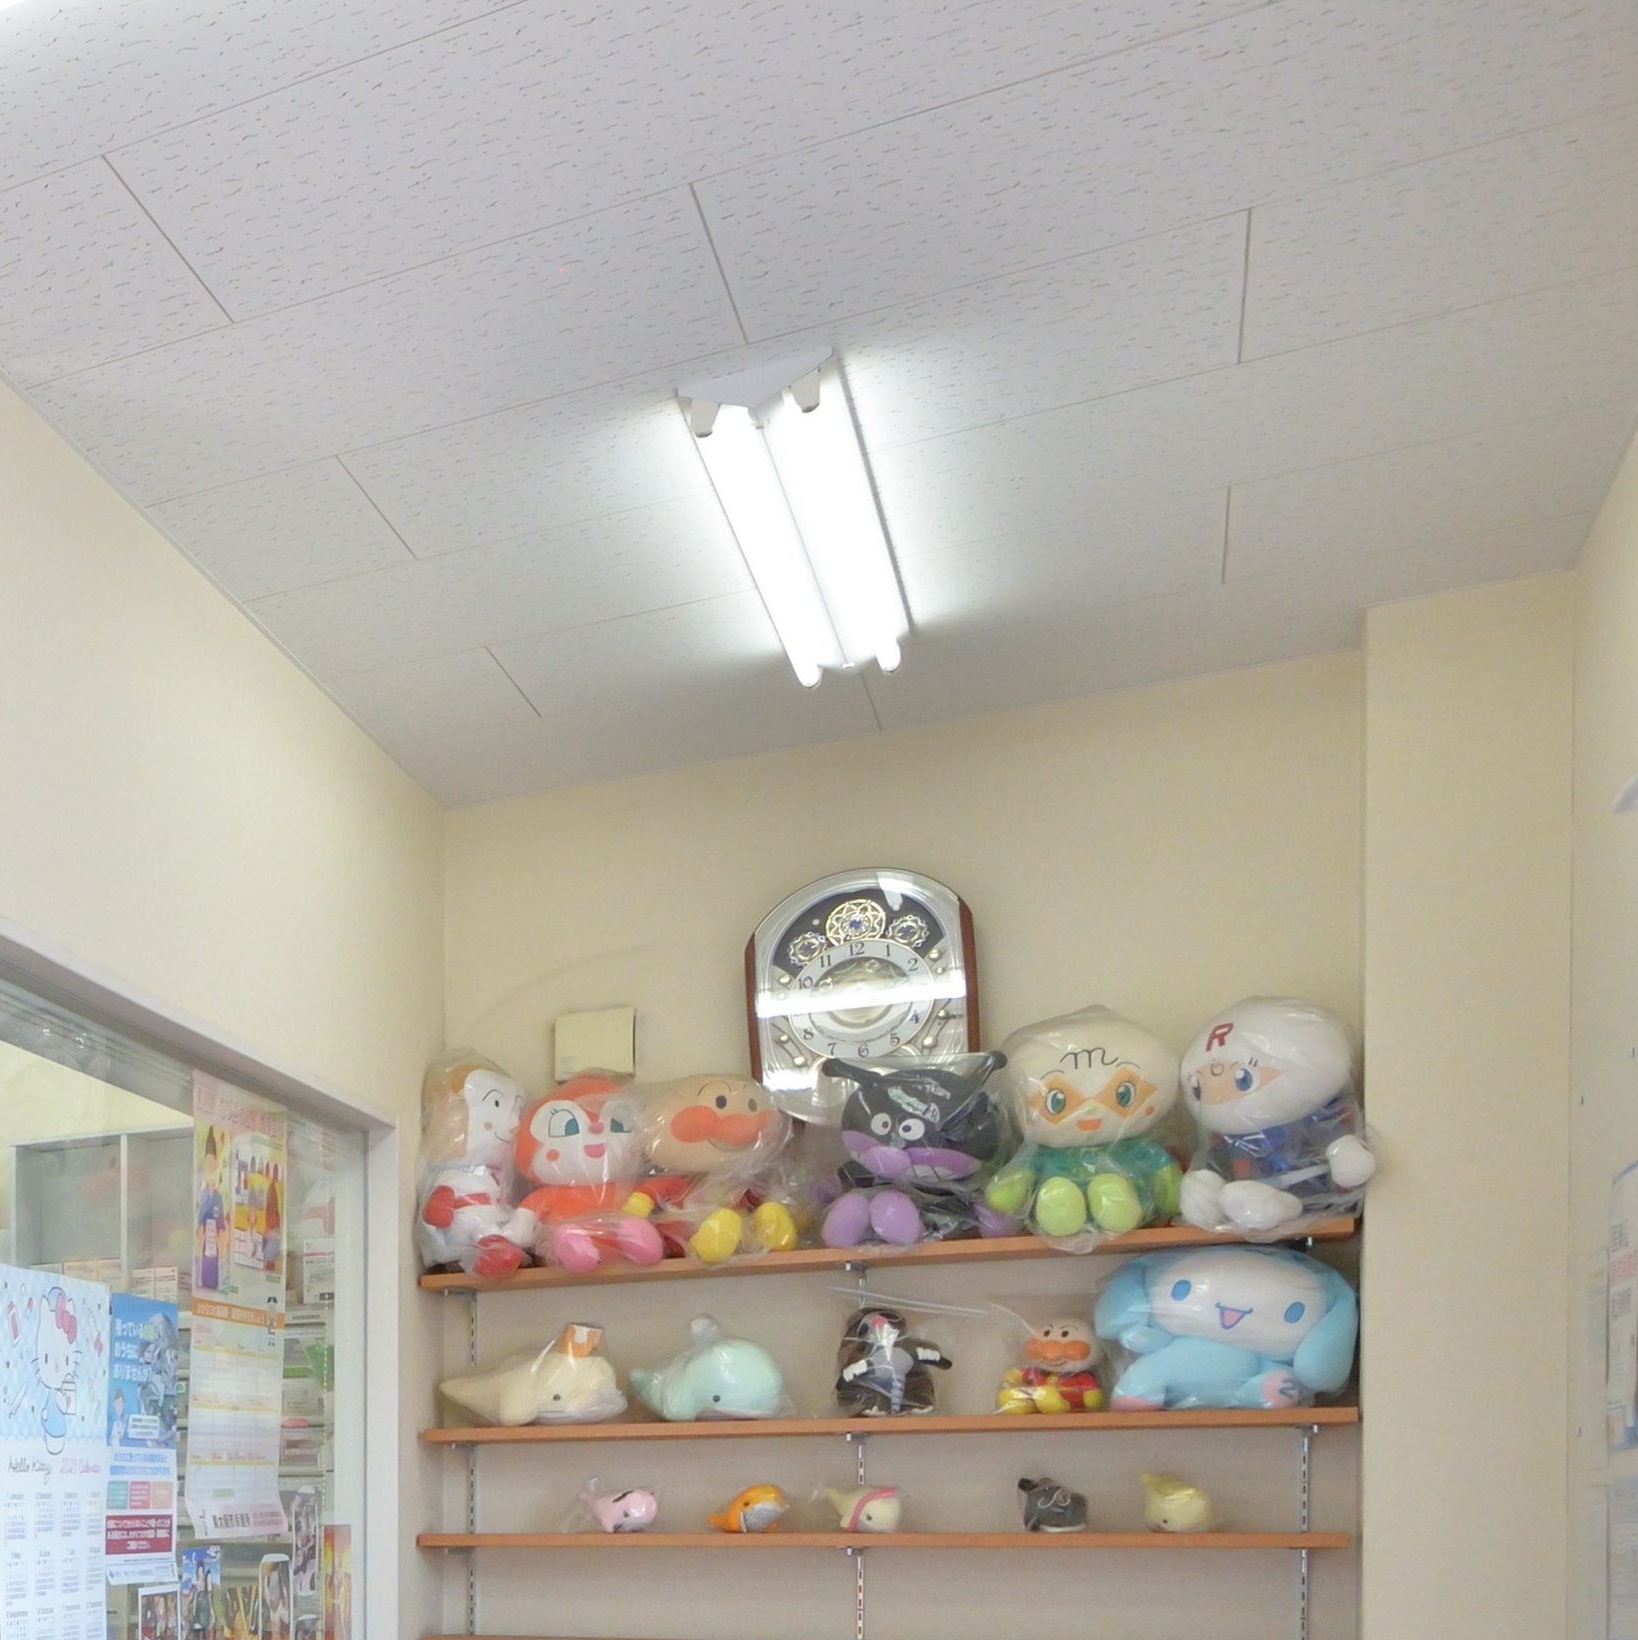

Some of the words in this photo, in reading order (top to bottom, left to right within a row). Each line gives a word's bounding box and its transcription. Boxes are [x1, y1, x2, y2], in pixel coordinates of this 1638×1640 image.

[849, 942, 865, 955] 12
[886, 945, 890, 957] 1
[819, 954, 832, 968] 11
[907, 958, 919, 971] 2
[798, 977, 813, 990] 10
[910, 1013, 920, 1024] 4
[803, 1028, 814, 1040] 8
[890, 1033, 900, 1046] 5
[1205, 1022, 1234, 1052] R
[827, 1042, 837, 1055] 7
[858, 1044, 869, 1057] 6
[8, 1456, 30, 1475] Hello
